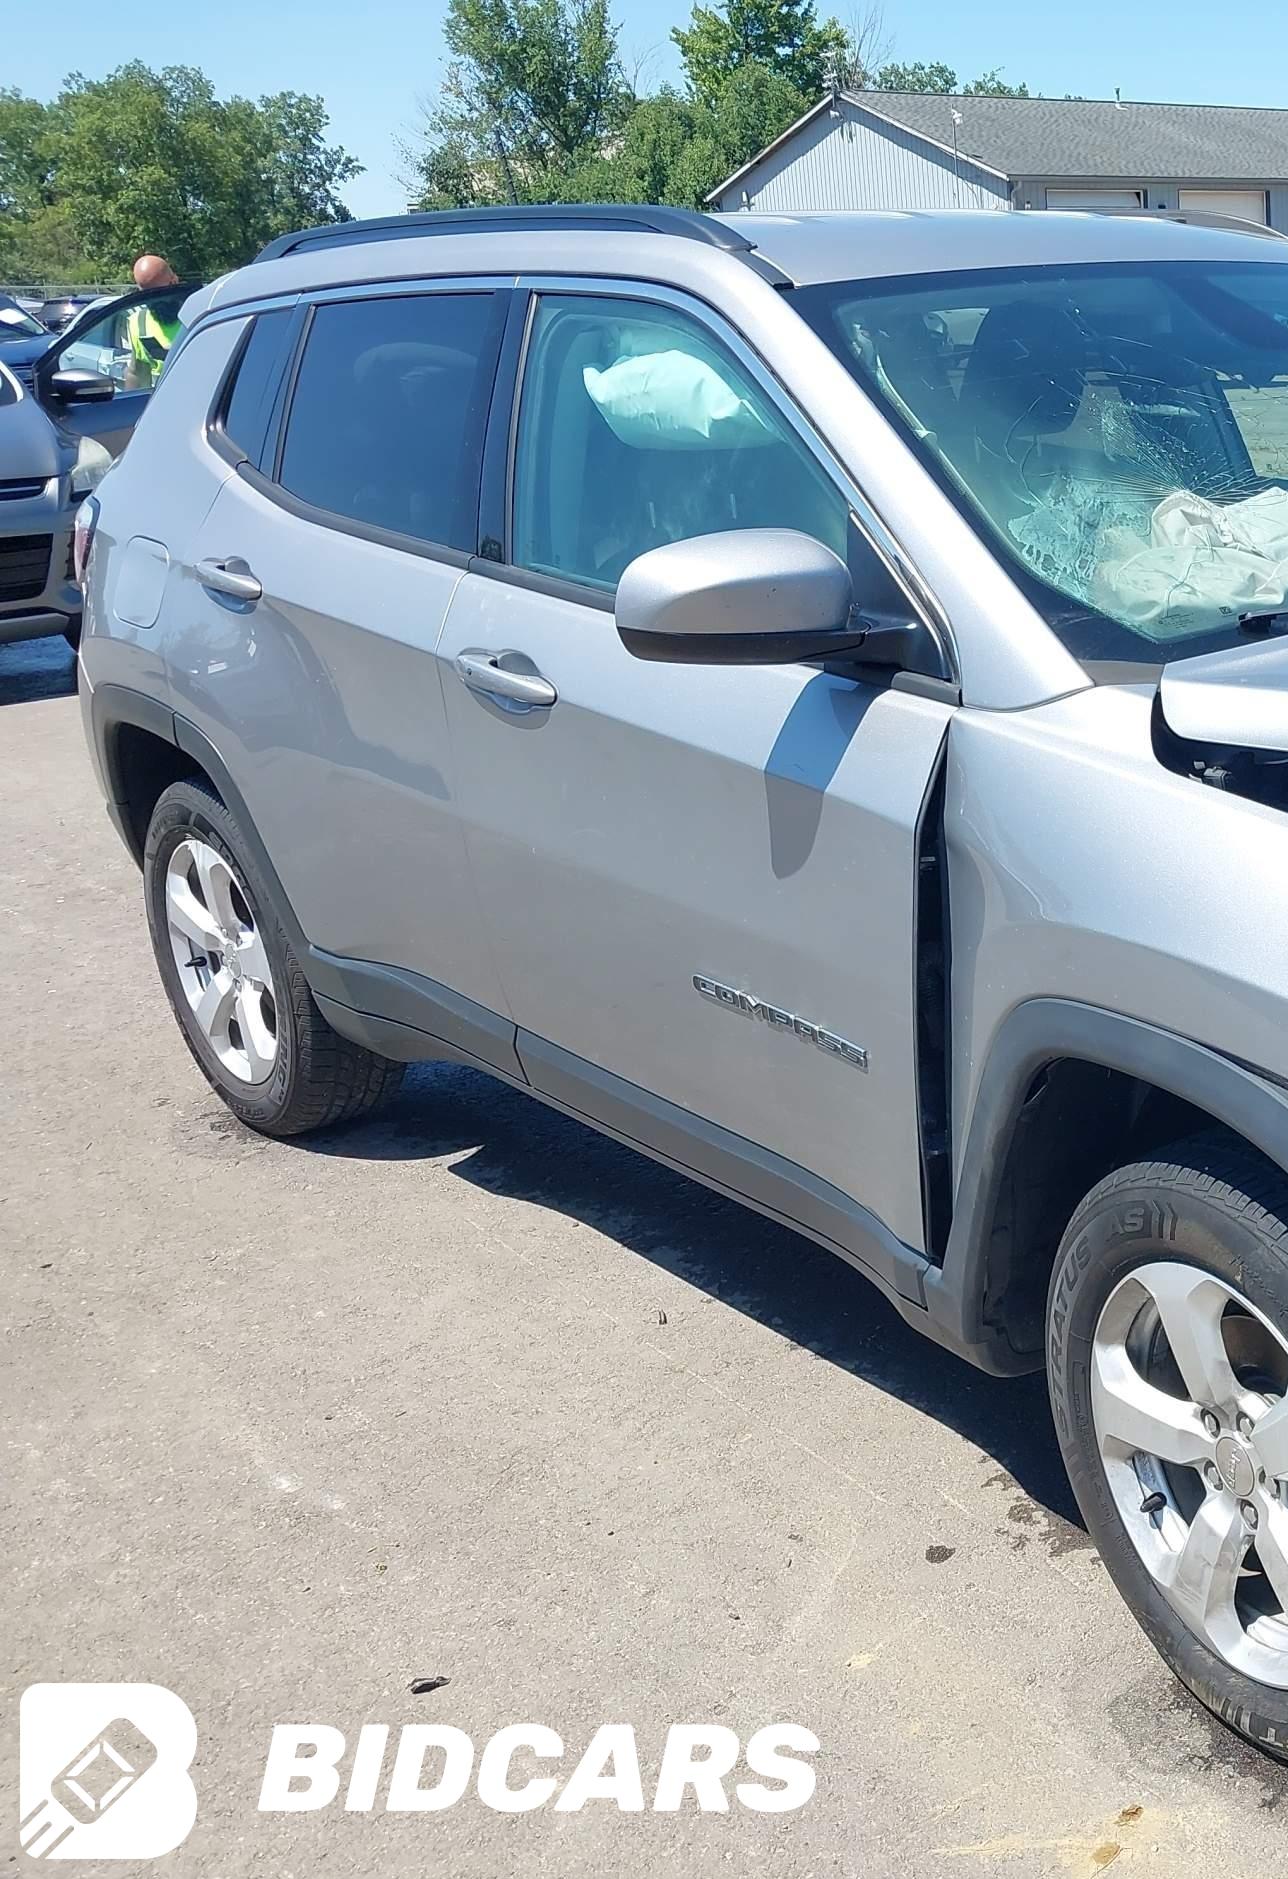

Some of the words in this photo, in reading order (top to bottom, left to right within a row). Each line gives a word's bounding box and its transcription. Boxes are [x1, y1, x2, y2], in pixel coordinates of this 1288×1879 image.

[692, 974, 869, 1069] COMPASS
[1048, 1235, 1092, 1439] STRATUS
[1105, 1206, 1146, 1241] AS
